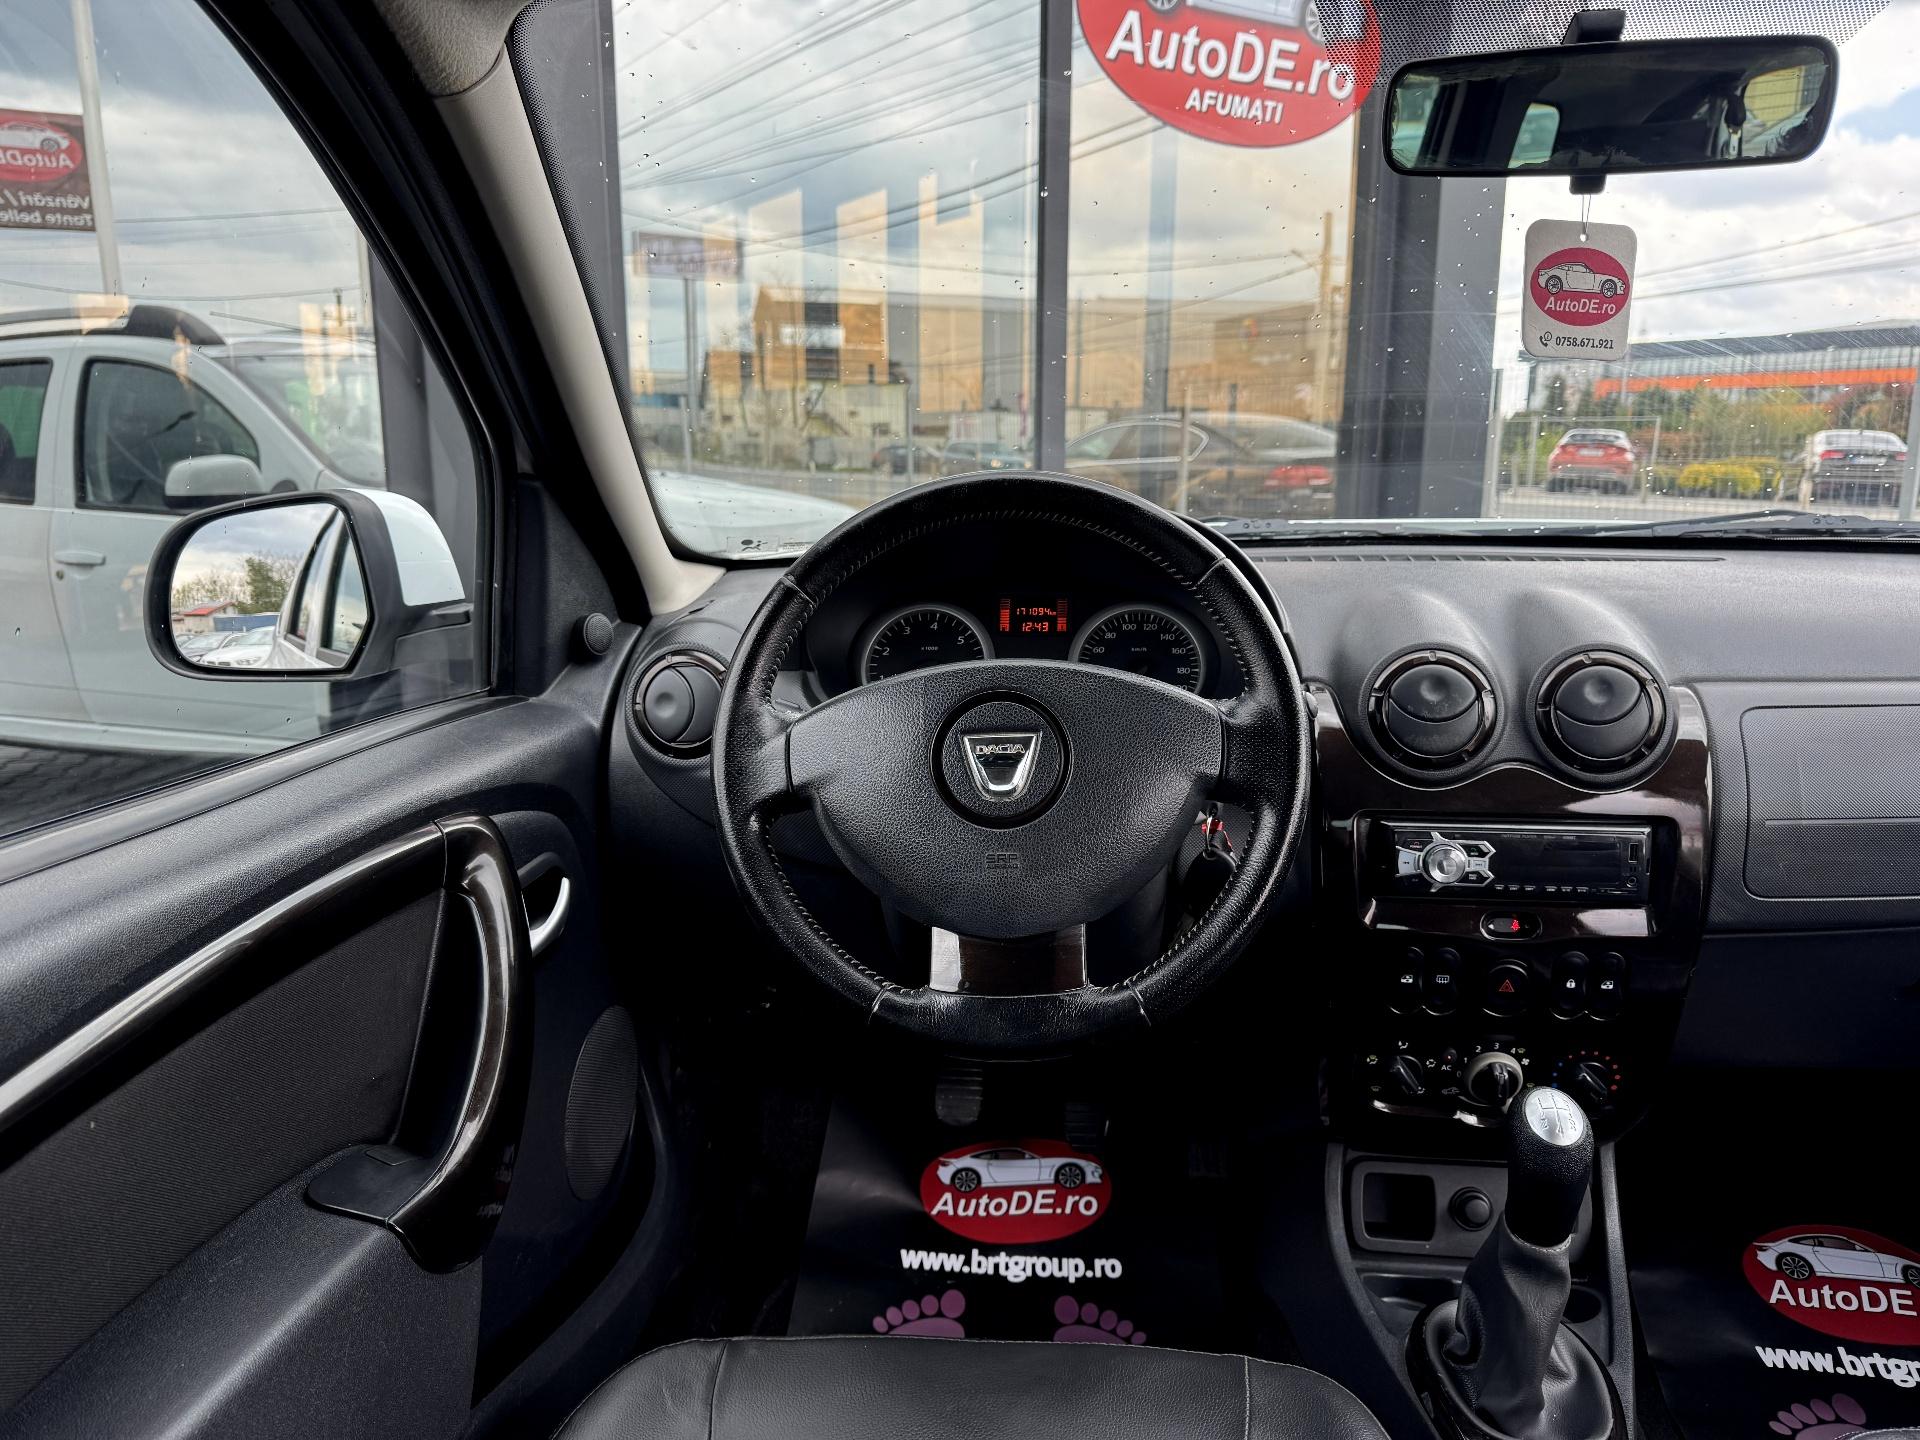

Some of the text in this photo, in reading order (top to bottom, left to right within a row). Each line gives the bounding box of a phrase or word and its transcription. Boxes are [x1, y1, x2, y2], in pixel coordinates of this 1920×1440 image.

[1105, 9, 1355, 100] AutoDE.ro
[1544, 296, 1616, 315] AutoDE.ro
[1555, 336, 1614, 350] 0758.671.921
[903, 626, 911, 635] 3
[930, 622, 938, 630] 4
[956, 636, 965, 645] 5
[1160, 633, 1175, 641] 140
[882, 647, 890, 656] 2
[1093, 646, 1105, 654] 60
[1172, 647, 1186, 655] 160
[975, 743, 1025, 754] DACIA
[1475, 1045, 1482, 1053] 2
[1493, 1042, 1500, 1050] 3
[930, 1189, 1098, 1217] AutoDE.ro
[900, 1249, 1122, 1283] www.brtgroup.ro
[1769, 1279, 1918, 1317] AutoDE
